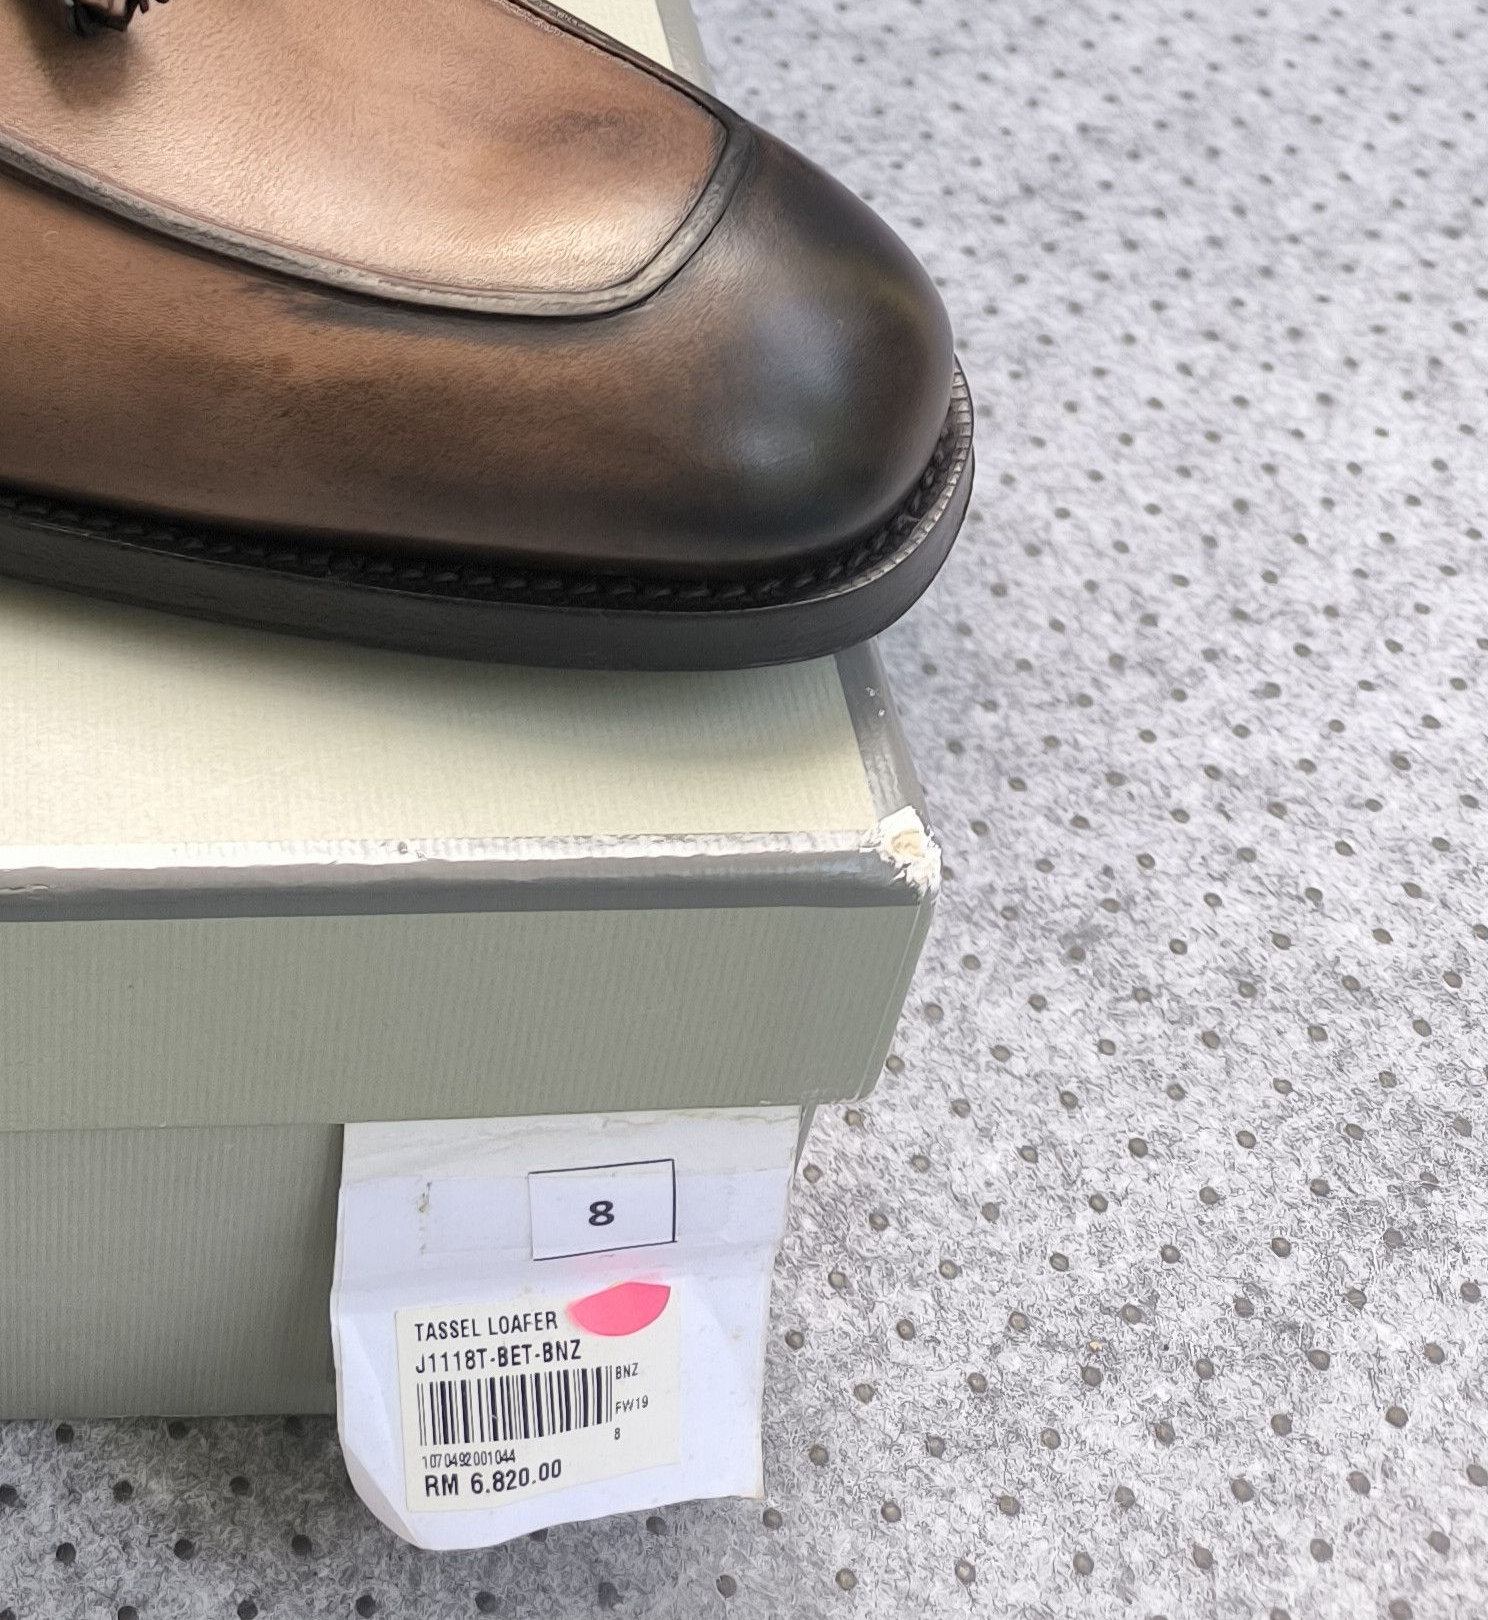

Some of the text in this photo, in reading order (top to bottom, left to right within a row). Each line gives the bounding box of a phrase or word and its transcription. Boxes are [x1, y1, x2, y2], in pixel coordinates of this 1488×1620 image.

[588, 1200, 615, 1227] 8
[414, 1311, 559, 1342] TASSEL LOAFER
[415, 1339, 582, 1374] J1118T-BET-BNZ
[615, 1362, 639, 1380] BNZ
[615, 1394, 649, 1414] FW19
[614, 1427, 621, 1440] 8
[422, 1448, 516, 1470] 1070492001044
[425, 1458, 562, 1497] RM 6.820.00
